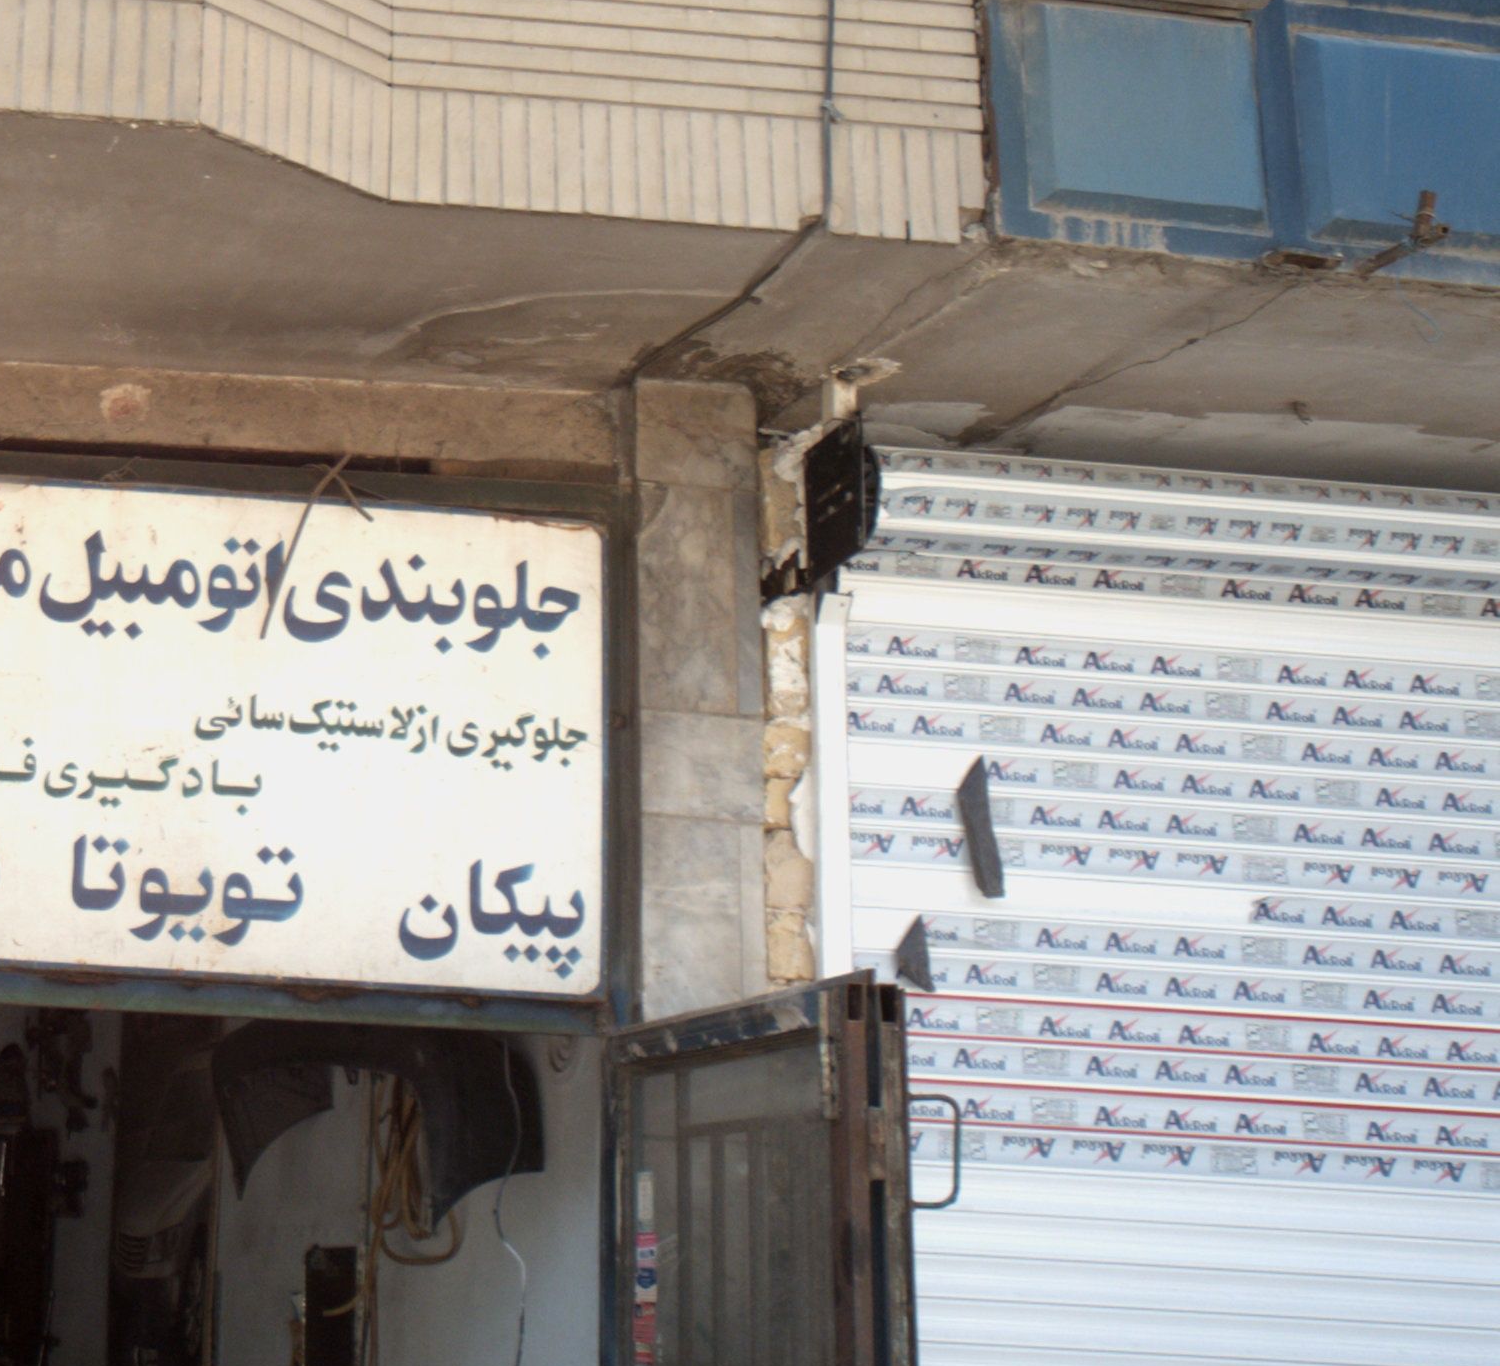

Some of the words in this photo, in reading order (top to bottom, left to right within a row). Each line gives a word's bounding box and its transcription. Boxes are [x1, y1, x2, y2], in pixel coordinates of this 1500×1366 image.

[39, 530, 285, 639] اتومبیل
[283, 554, 581, 660] جلوبندی
[446, 712, 588, 771] جلوگیری
[71, 834, 304, 946] تویوتا
[399, 858, 587, 979] پیکان
